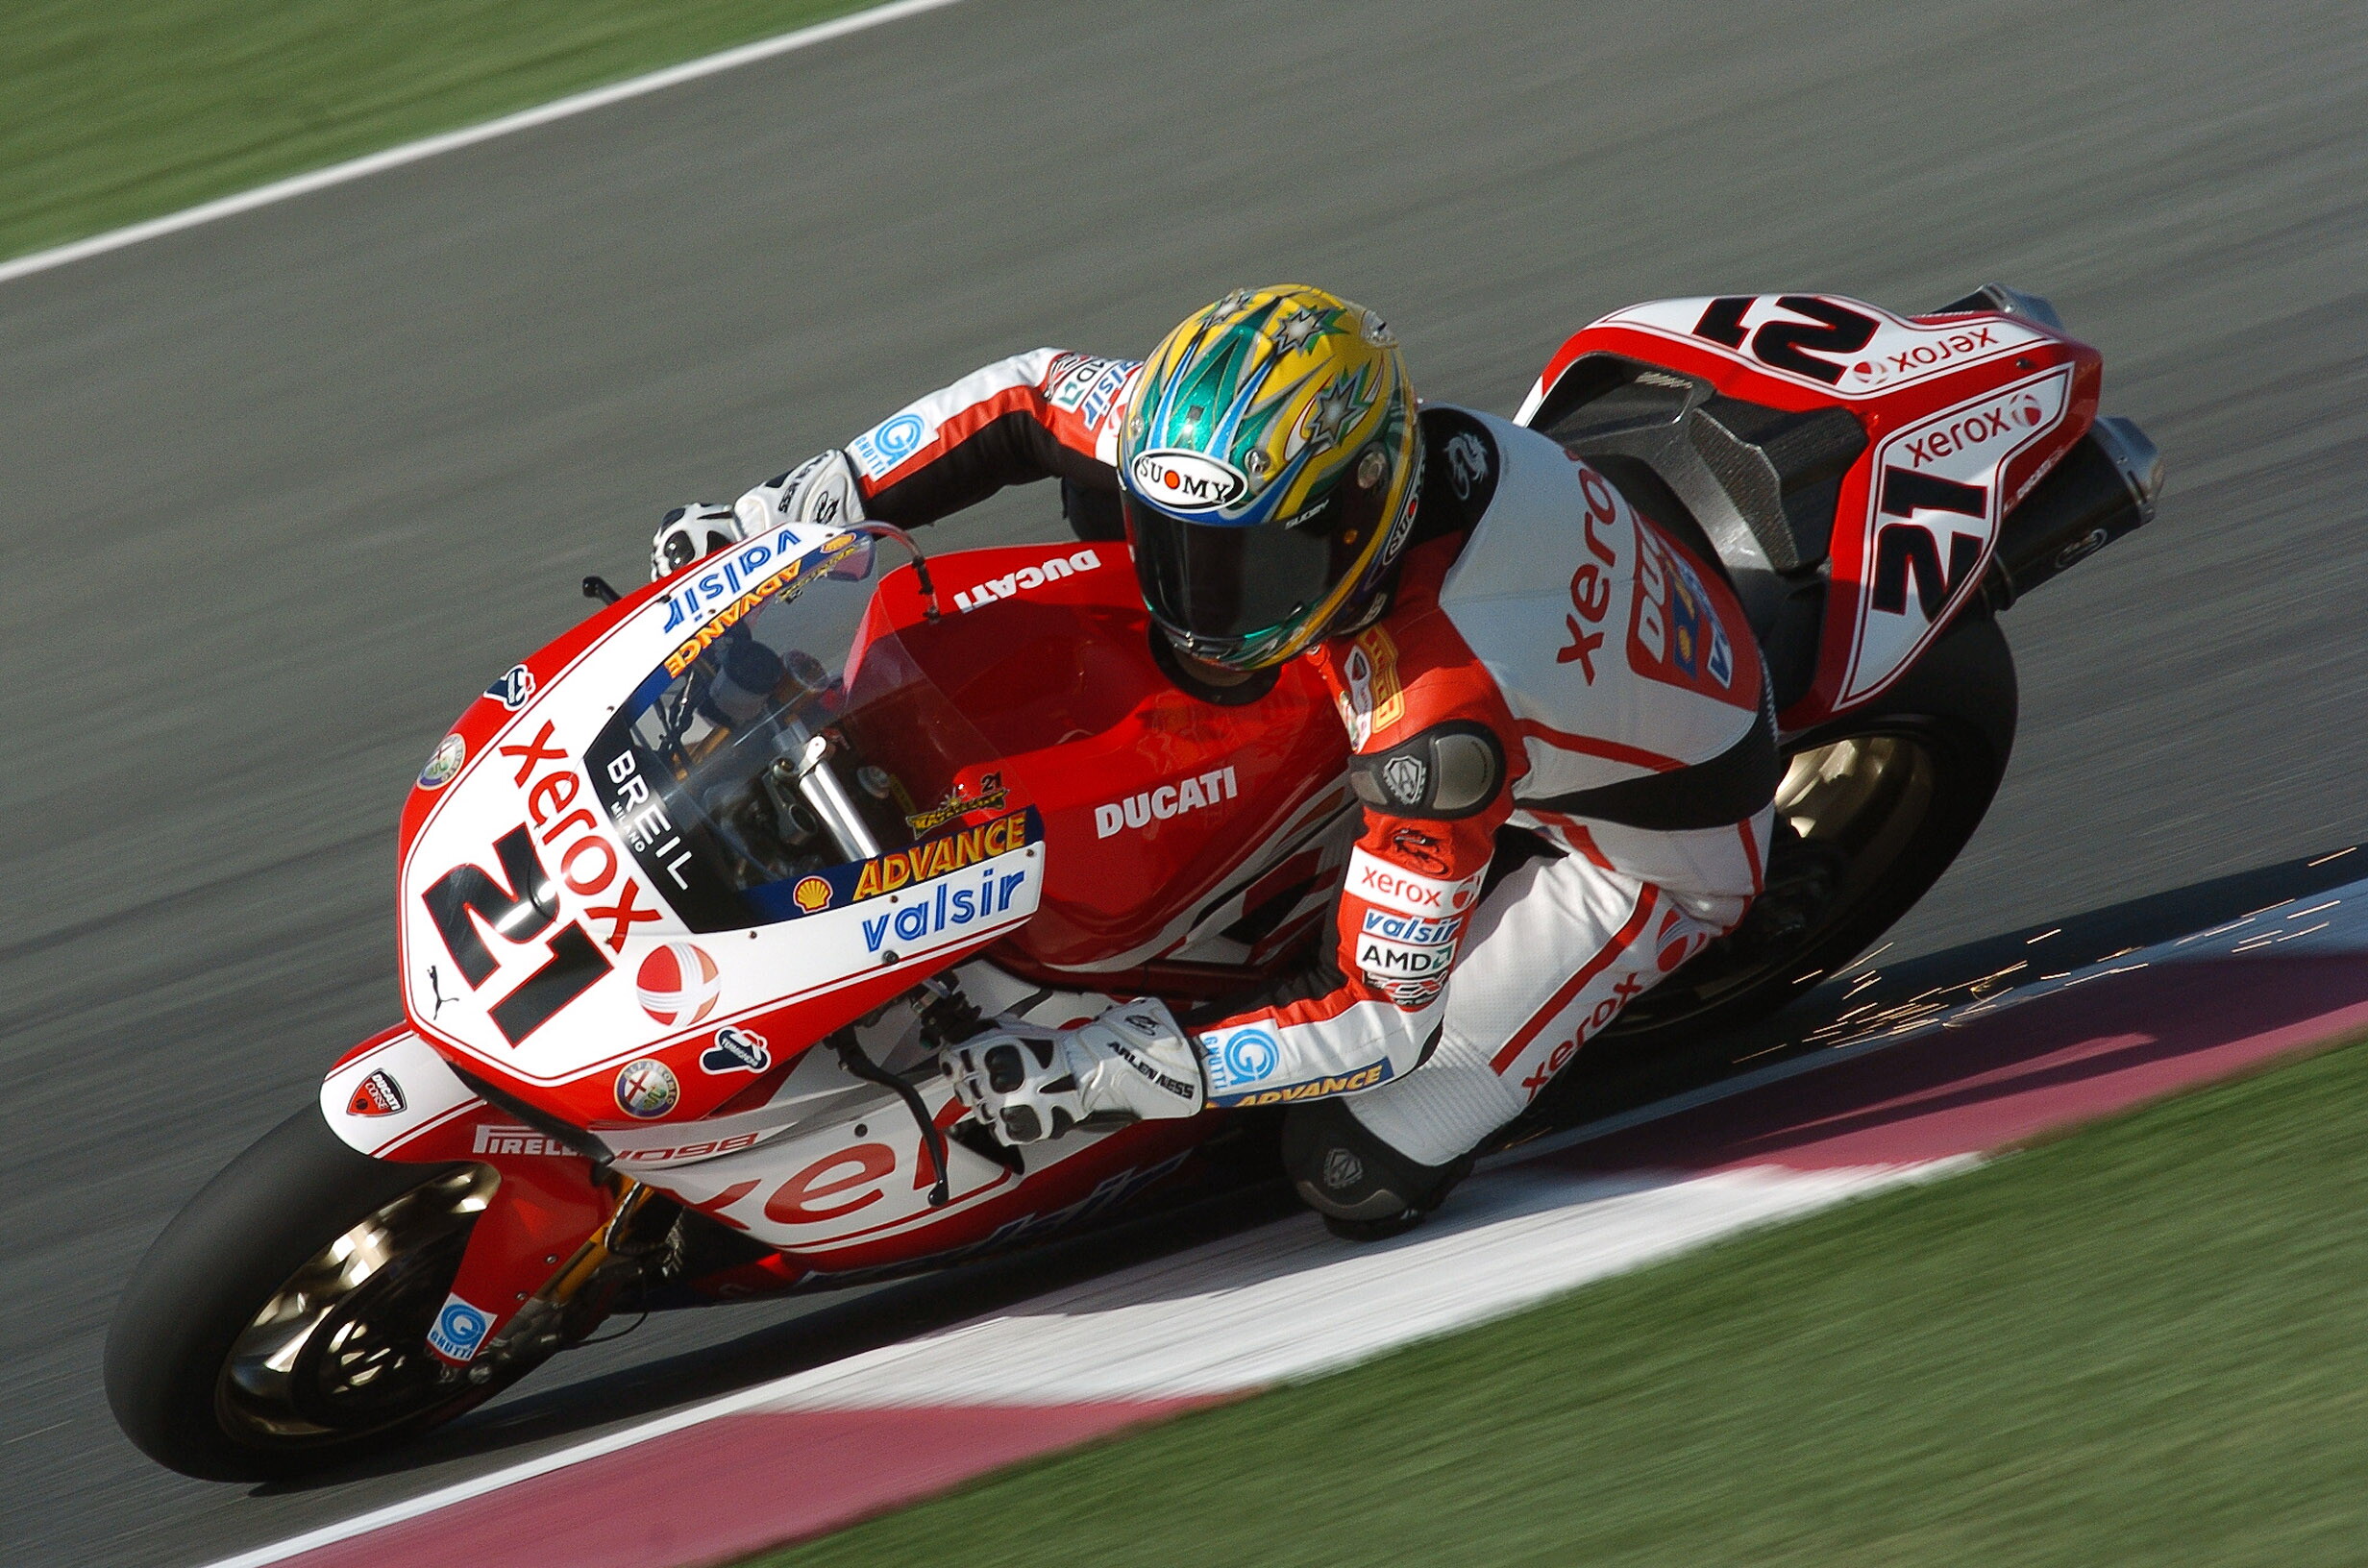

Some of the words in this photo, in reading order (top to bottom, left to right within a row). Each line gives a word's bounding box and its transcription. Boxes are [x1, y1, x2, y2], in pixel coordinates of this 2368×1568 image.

[1691, 295, 1882, 386] 21
[1887, 327, 2000, 375] xerox
[1085, 360, 1140, 424] alsir
[1904, 406, 2011, 468] xerox
[1139, 455, 1231, 503] SUOMY
[1556, 447, 1618, 686] xero
[1870, 464, 1989, 625] 21
[663, 528, 802, 633] valsir
[952, 549, 1102, 614] DUCATI
[664, 558, 803, 679] ADVANCE
[499, 719, 662, 954] xerox
[606, 749, 693, 891] BREIL
[610, 800, 646, 853] MILANO
[1094, 765, 1239, 840] DUCATI
[851, 810, 1027, 902] ADVANCE
[1361, 866, 1442, 907] xerox
[421, 821, 615, 1049] 21
[862, 868, 1025, 953] valsir
[1365, 912, 1459, 943] valsir
[1362, 944, 1432, 971] AMD
[1521, 972, 1642, 1104] xerox
[371, 1073, 401, 1111] DUCATI
[1155, 1073, 1195, 1099] NESS
[1236, 1064, 1383, 1108] ADVANCE
[472, 1124, 583, 1157] PIREL
[663, 1093, 972, 1231] xer
